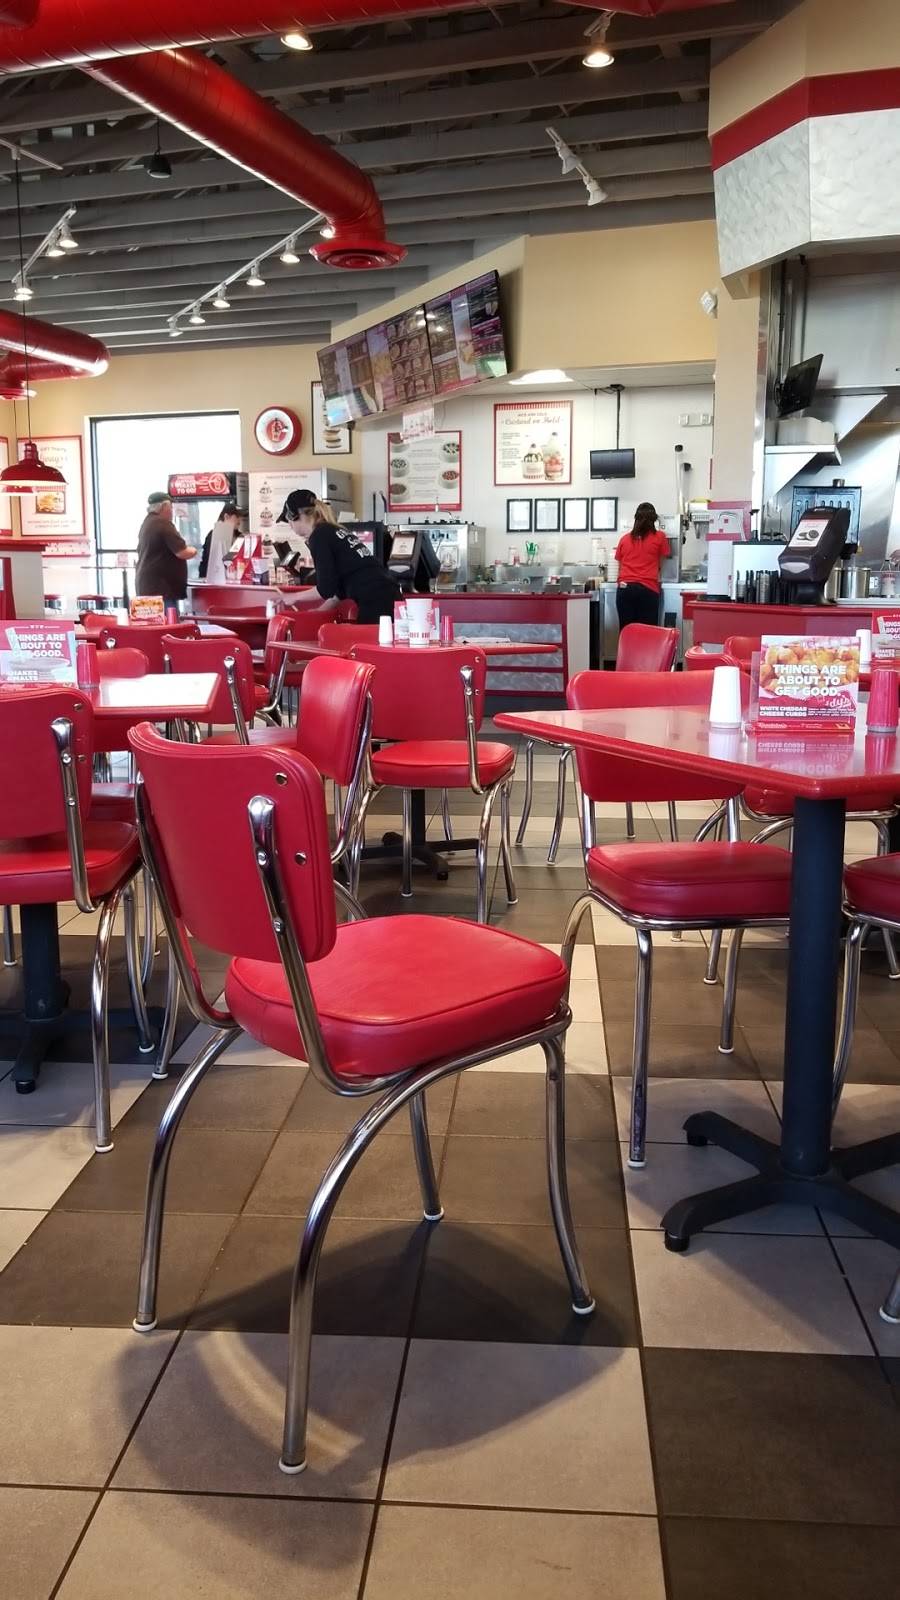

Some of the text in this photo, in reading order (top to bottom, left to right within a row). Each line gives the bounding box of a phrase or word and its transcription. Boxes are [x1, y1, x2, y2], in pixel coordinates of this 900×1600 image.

[773, 664, 846, 675] THINGS ARE
[777, 676, 840, 685] ABOUT TO
[775, 686, 841, 697] GET GOOD.
